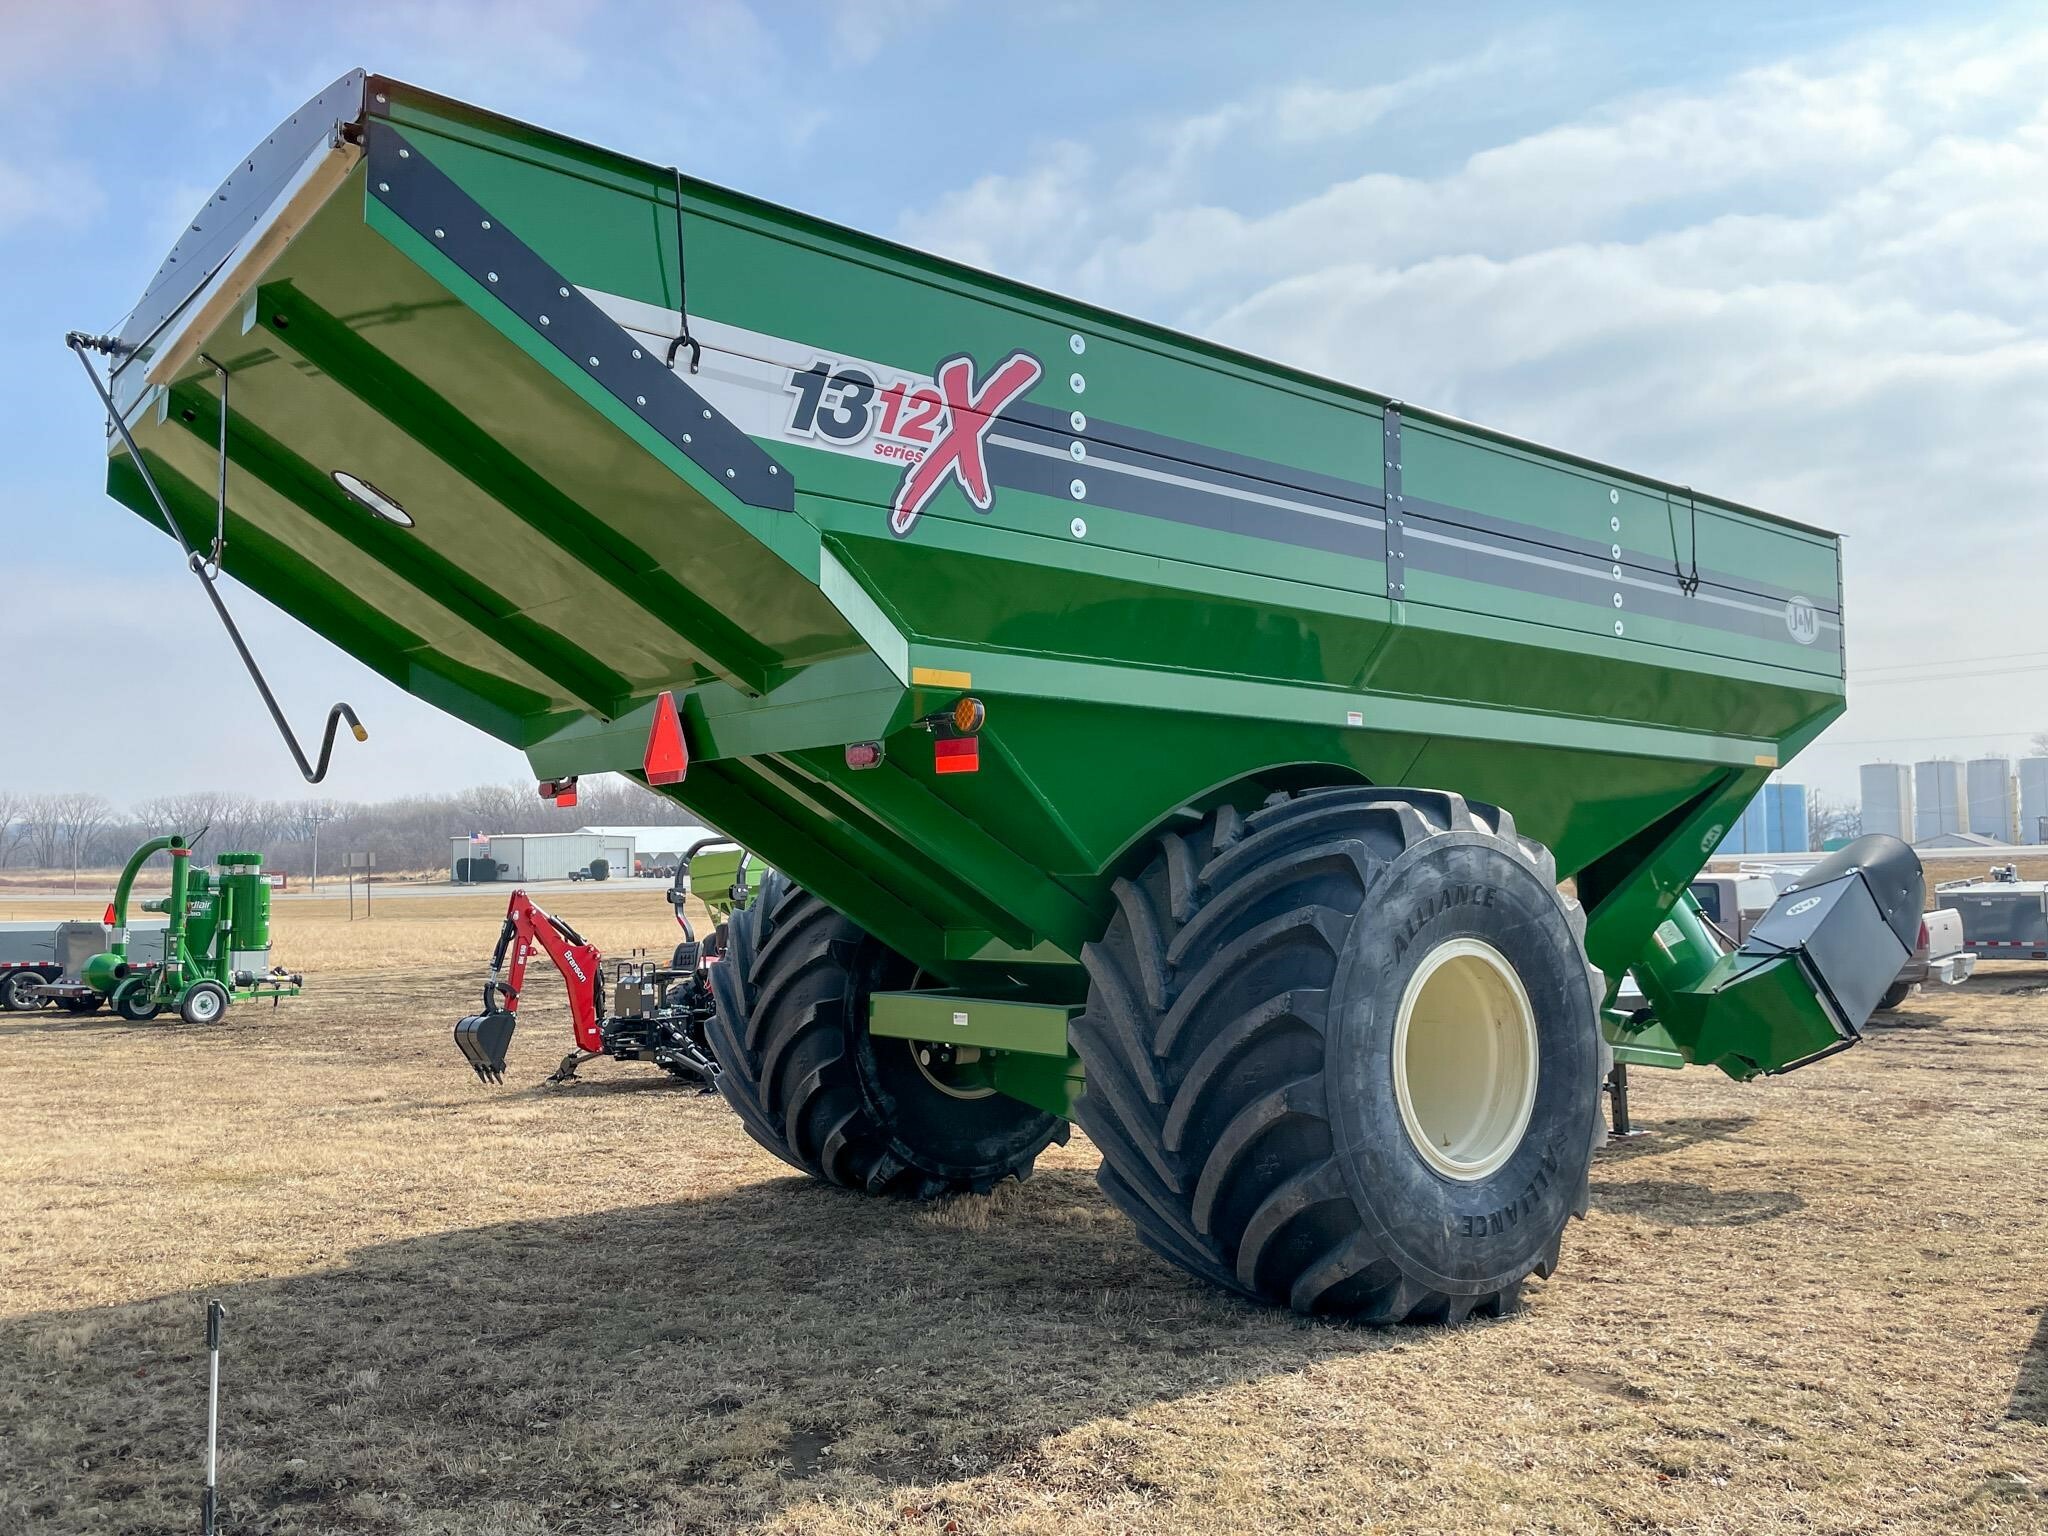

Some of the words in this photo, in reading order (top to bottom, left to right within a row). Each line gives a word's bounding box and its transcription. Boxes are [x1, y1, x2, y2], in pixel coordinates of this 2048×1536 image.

[873, 443, 923, 463] series
[1790, 604, 1814, 635] J&M
[1394, 883, 1497, 967] ALLIANCE
[564, 950, 587, 983] Branson
[1461, 1144, 1557, 1238] ALLIANCE
